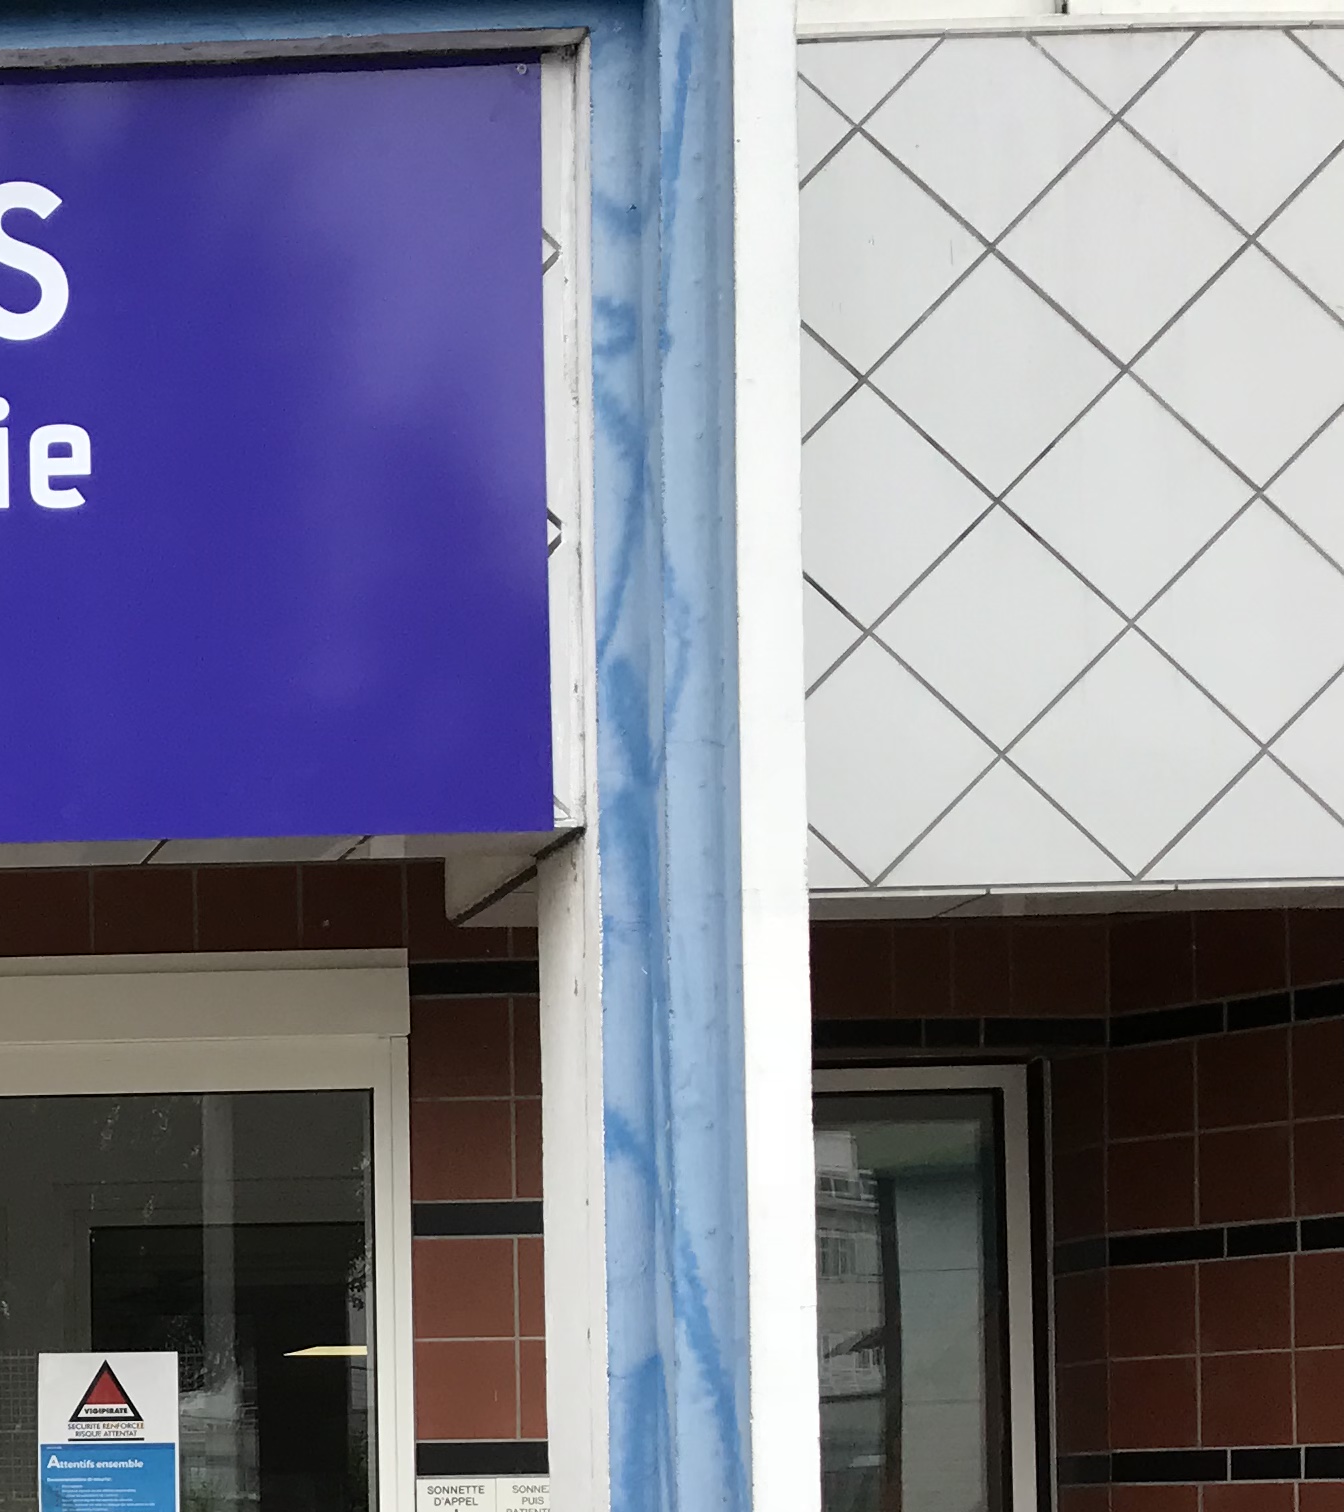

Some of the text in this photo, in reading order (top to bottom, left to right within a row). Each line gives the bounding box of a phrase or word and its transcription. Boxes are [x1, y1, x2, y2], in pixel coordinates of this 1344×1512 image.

[47, 1455, 144, 1469] Attentifs ensemble
[427, 1485, 485, 1495] SONNETTE
[434, 1497, 478, 1506] D'APPEL
[521, 1496, 544, 1505] PUIS
